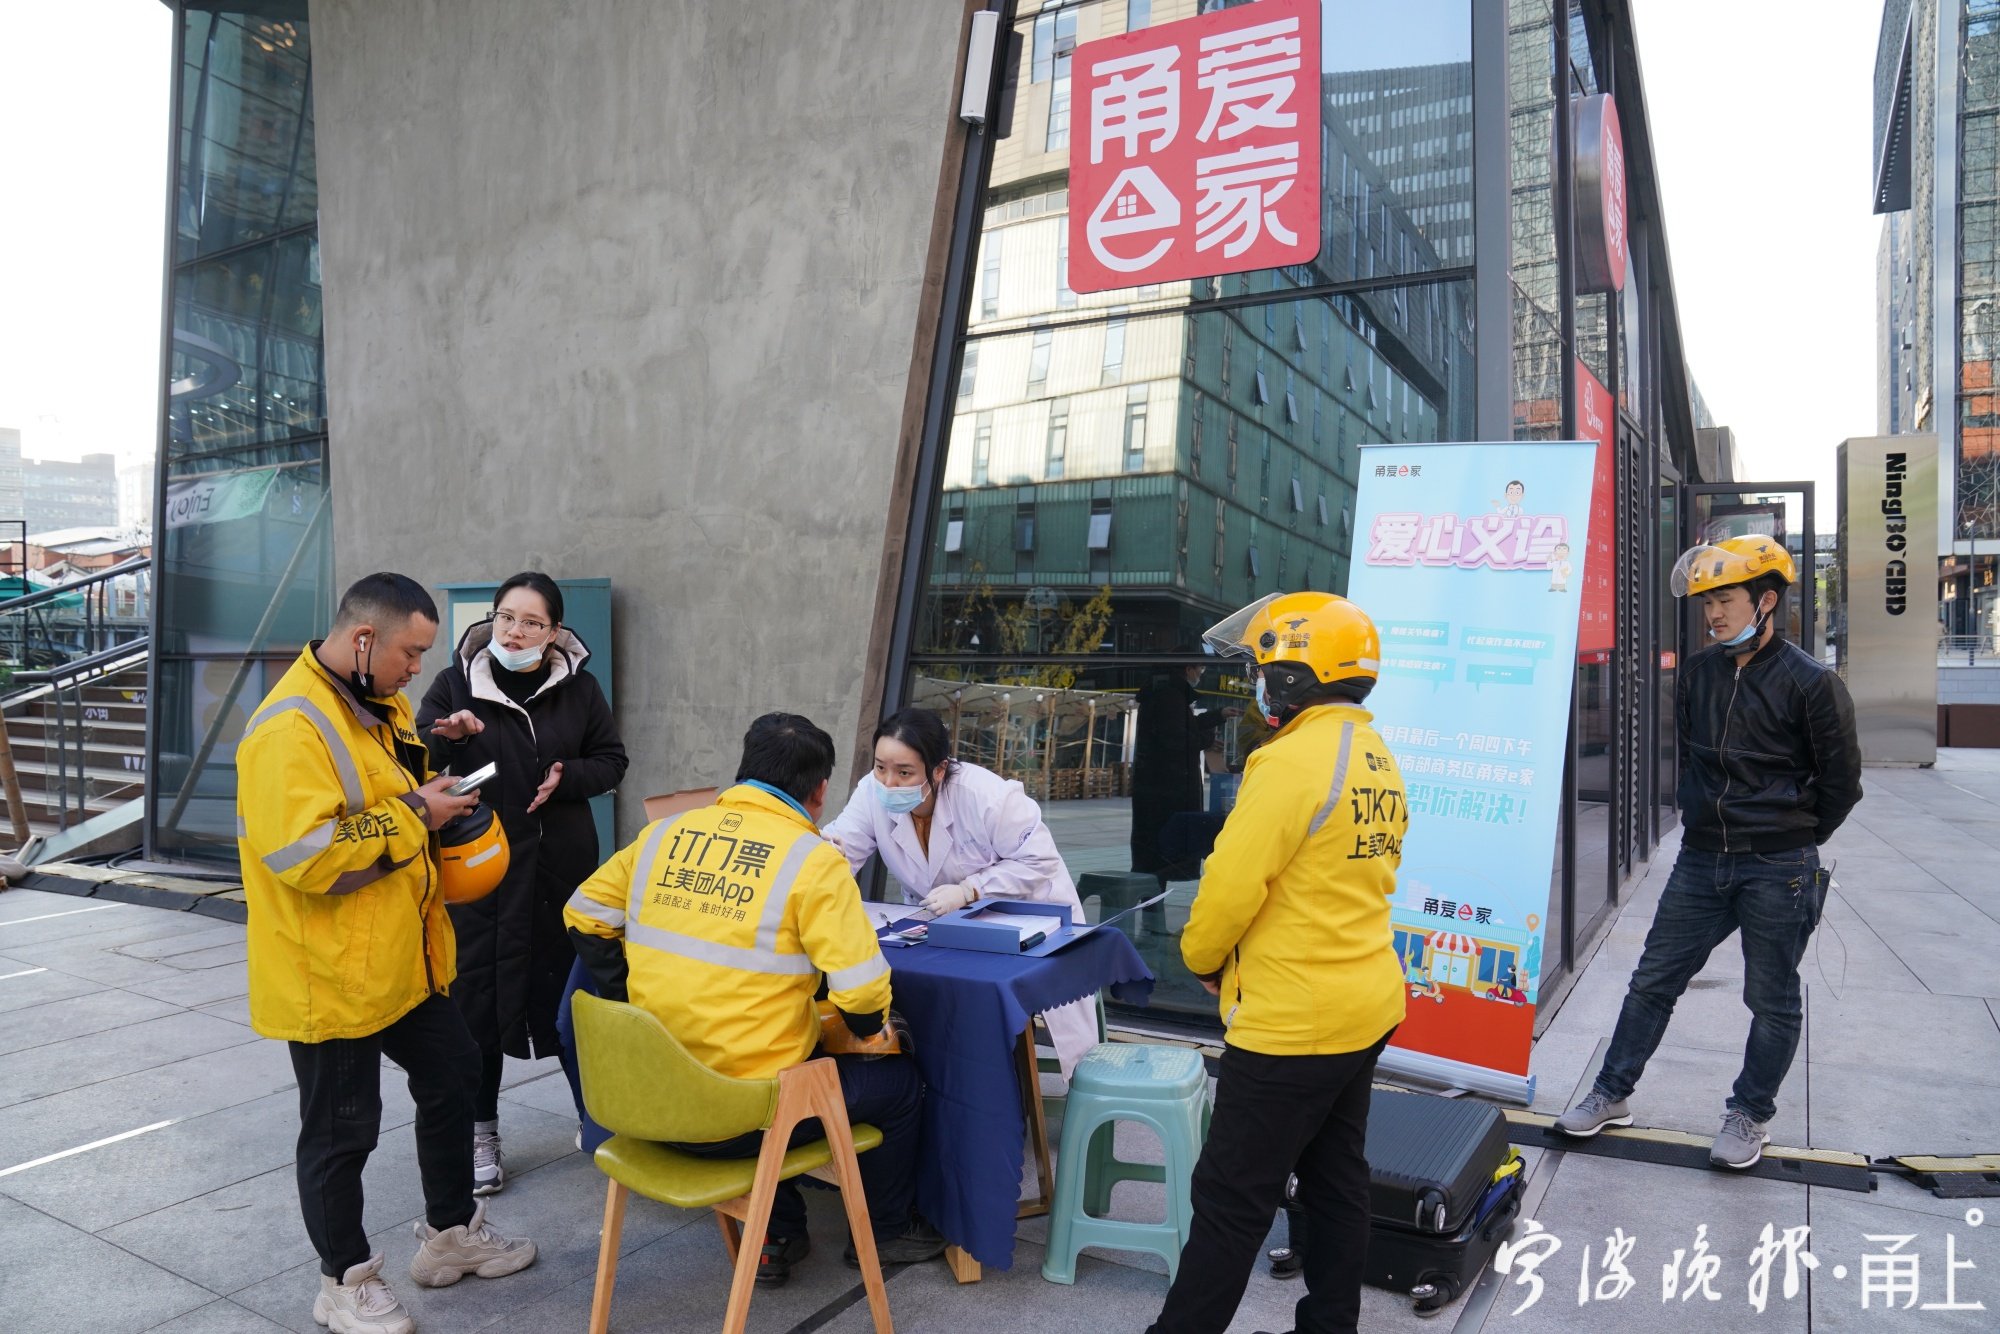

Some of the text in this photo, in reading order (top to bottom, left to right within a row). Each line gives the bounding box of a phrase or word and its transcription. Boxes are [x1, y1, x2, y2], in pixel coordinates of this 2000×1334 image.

[1369, 514, 1564, 565] 爱心义诊
[1382, 725, 1534, 757] 每月最后一个周四下午
[723, 818, 741, 828] 美团
[668, 827, 776, 878] 订门票
[656, 864, 755, 907] 上美团App
[652, 892, 747, 923] 美团配送 准时好用
[1423, 897, 1493, 926] 甬爱e家
